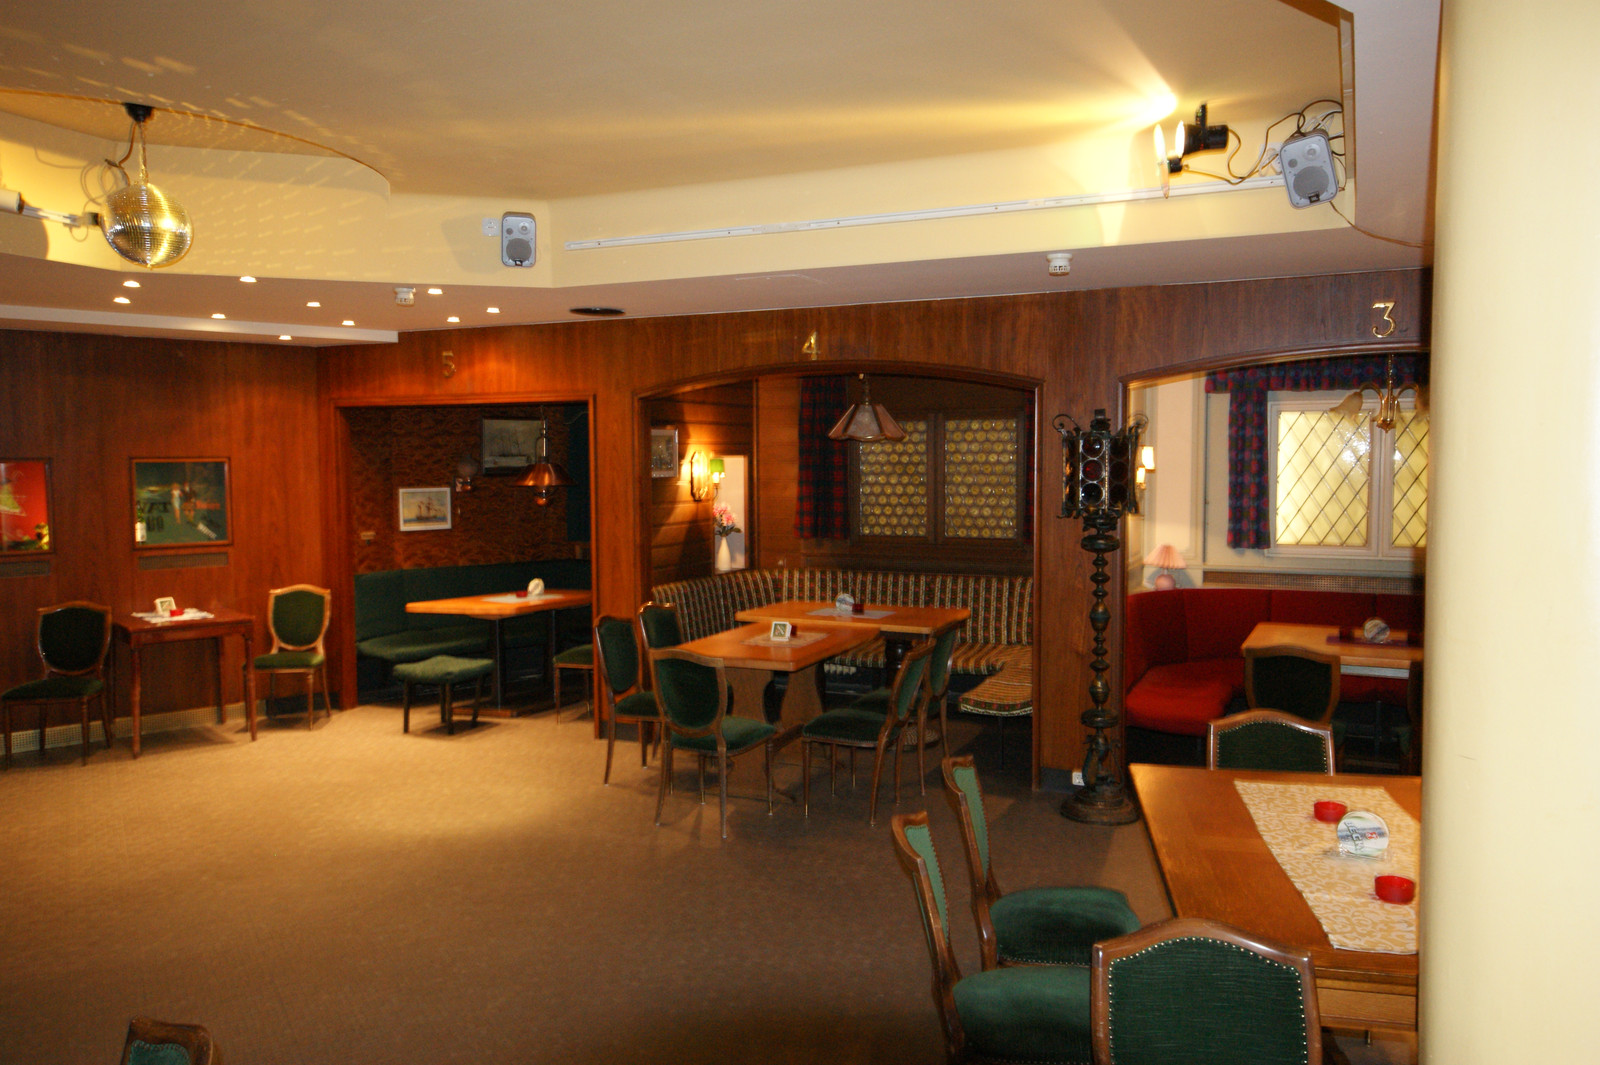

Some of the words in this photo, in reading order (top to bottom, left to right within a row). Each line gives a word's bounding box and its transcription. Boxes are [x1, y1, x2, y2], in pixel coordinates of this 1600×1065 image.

[1372, 301, 1396, 338] 3
[802, 331, 820, 361] 4
[442, 351, 456, 378] 5
